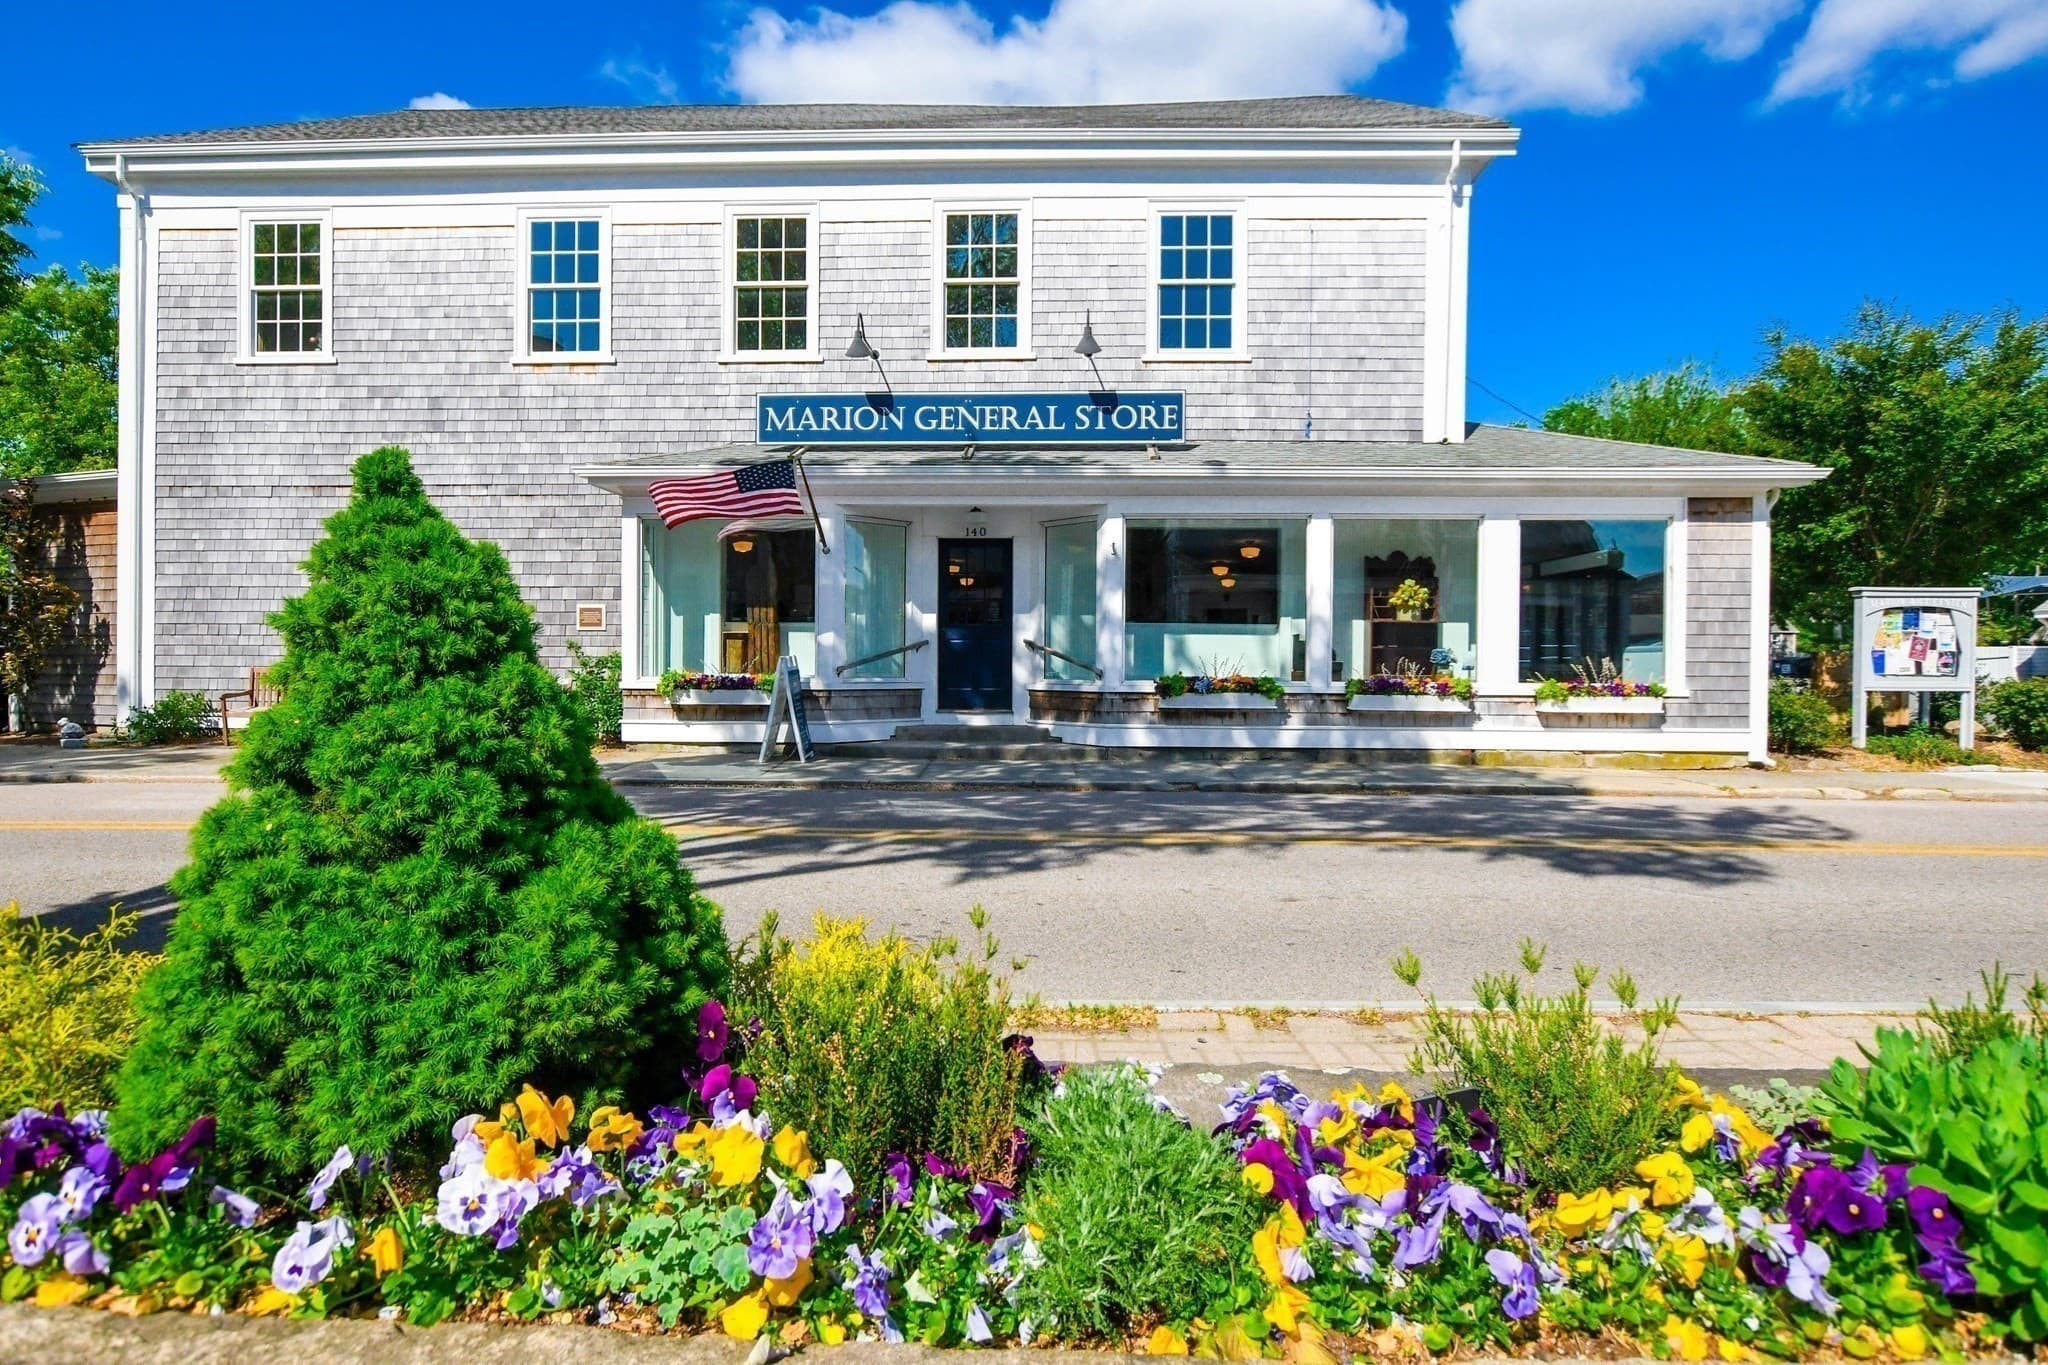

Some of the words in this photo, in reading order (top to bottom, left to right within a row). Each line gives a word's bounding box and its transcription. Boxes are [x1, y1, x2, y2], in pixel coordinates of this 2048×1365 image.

[765, 406, 906, 431] MARION
[914, 405, 1066, 430] GENERAL
[1075, 404, 1178, 430] STORE
[965, 527, 987, 537] 140
